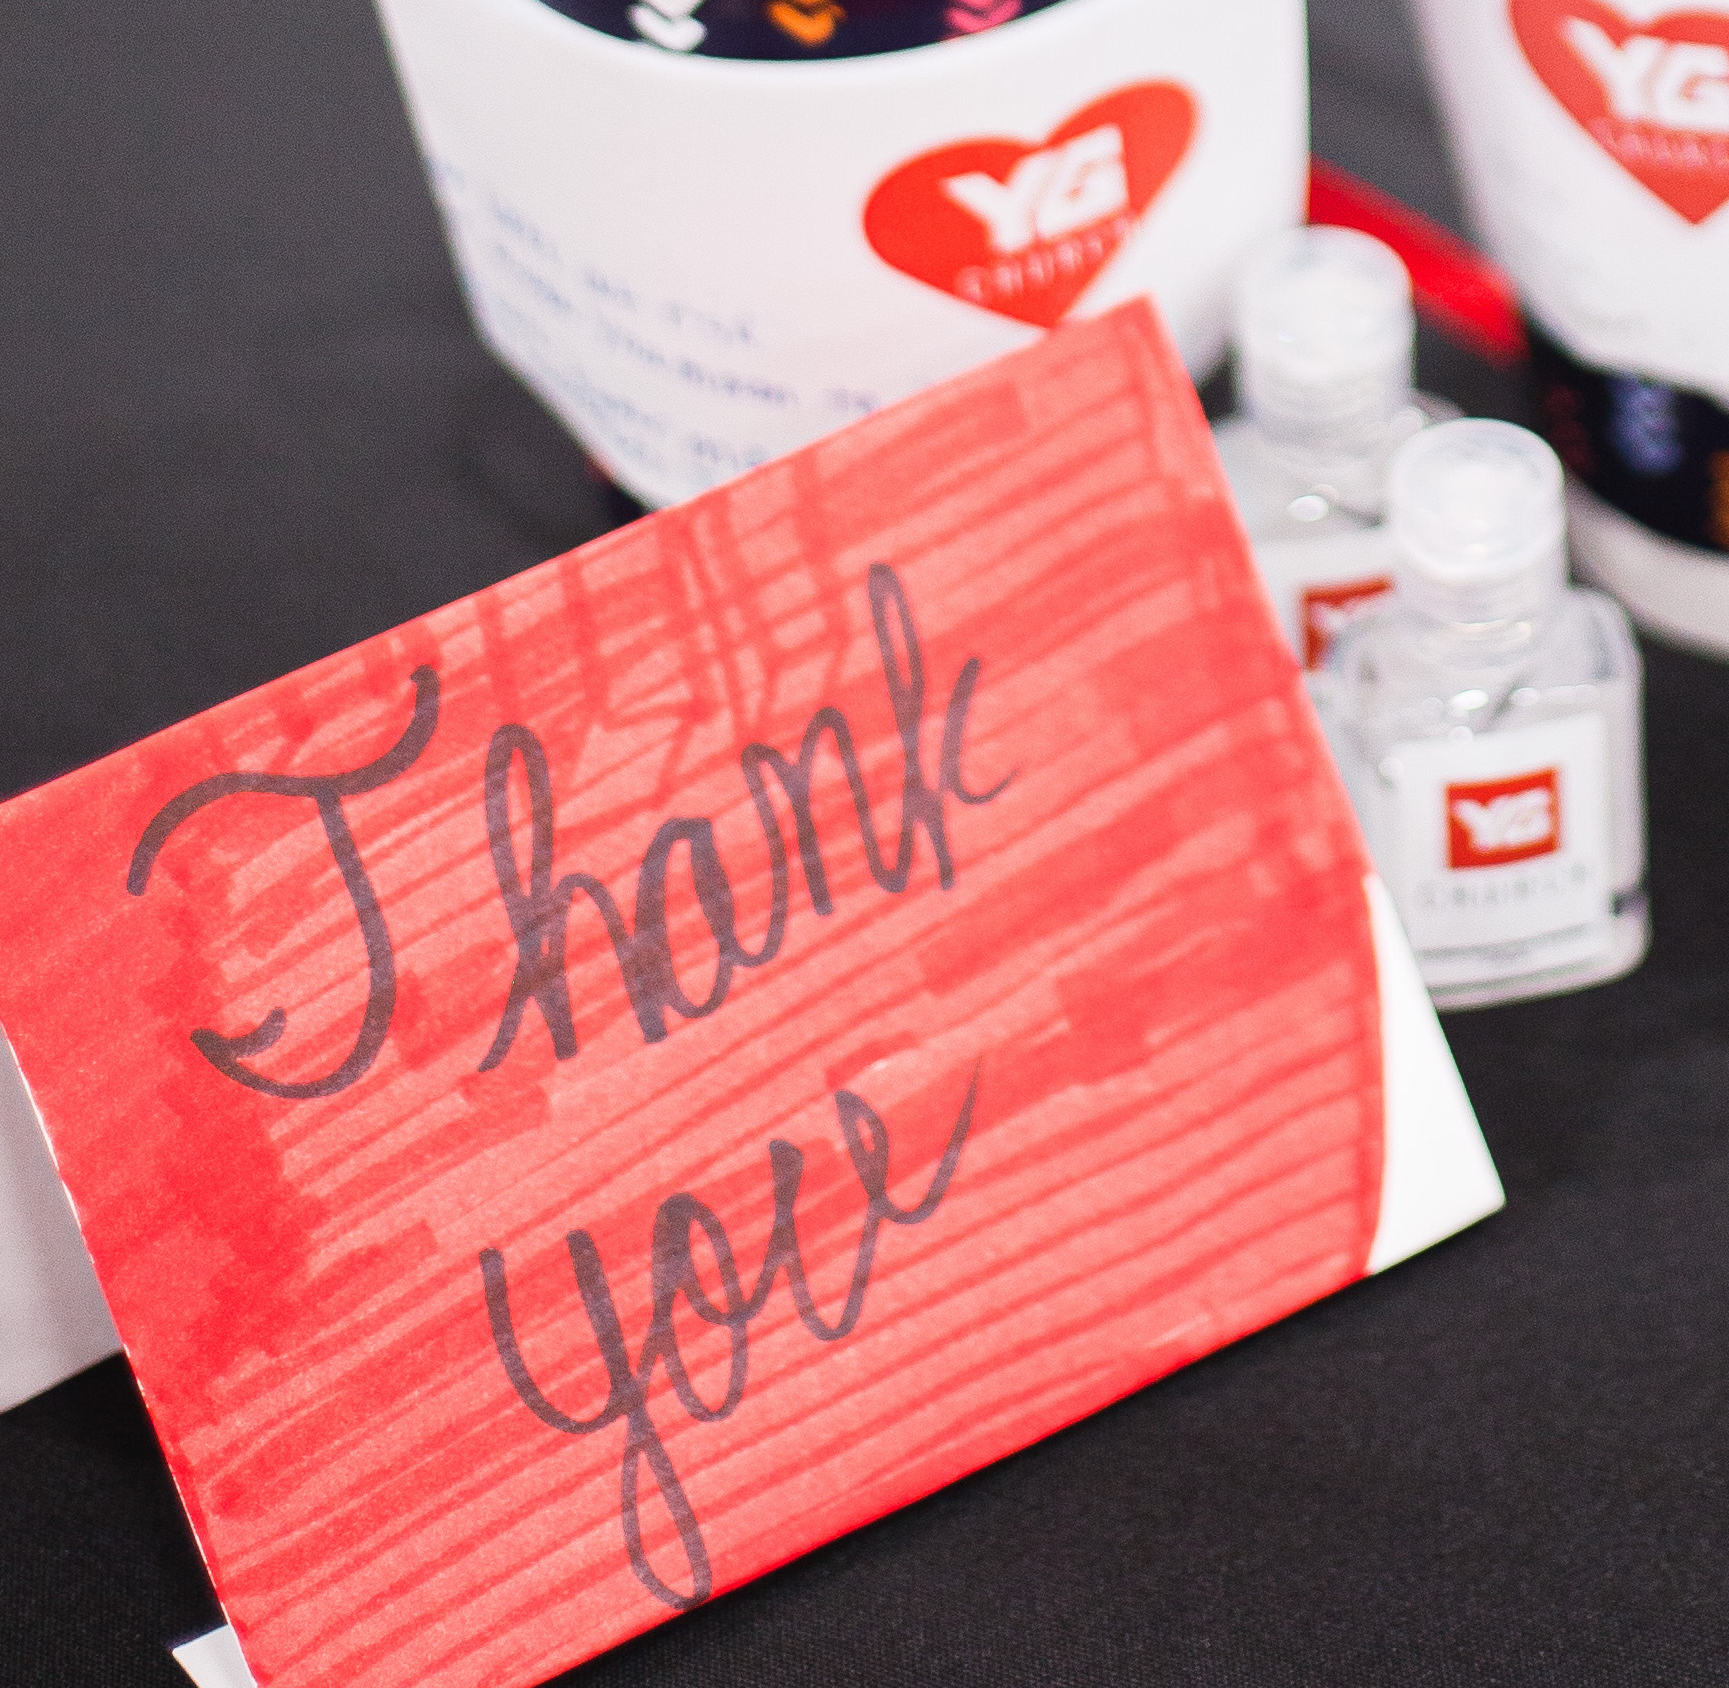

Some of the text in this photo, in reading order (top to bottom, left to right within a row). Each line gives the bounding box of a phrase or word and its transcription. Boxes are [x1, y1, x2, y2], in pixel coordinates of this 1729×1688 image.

[940, 125, 1130, 255] YG
[126, 562, 1016, 1103] Thank
[478, 1055, 984, 1612] you
